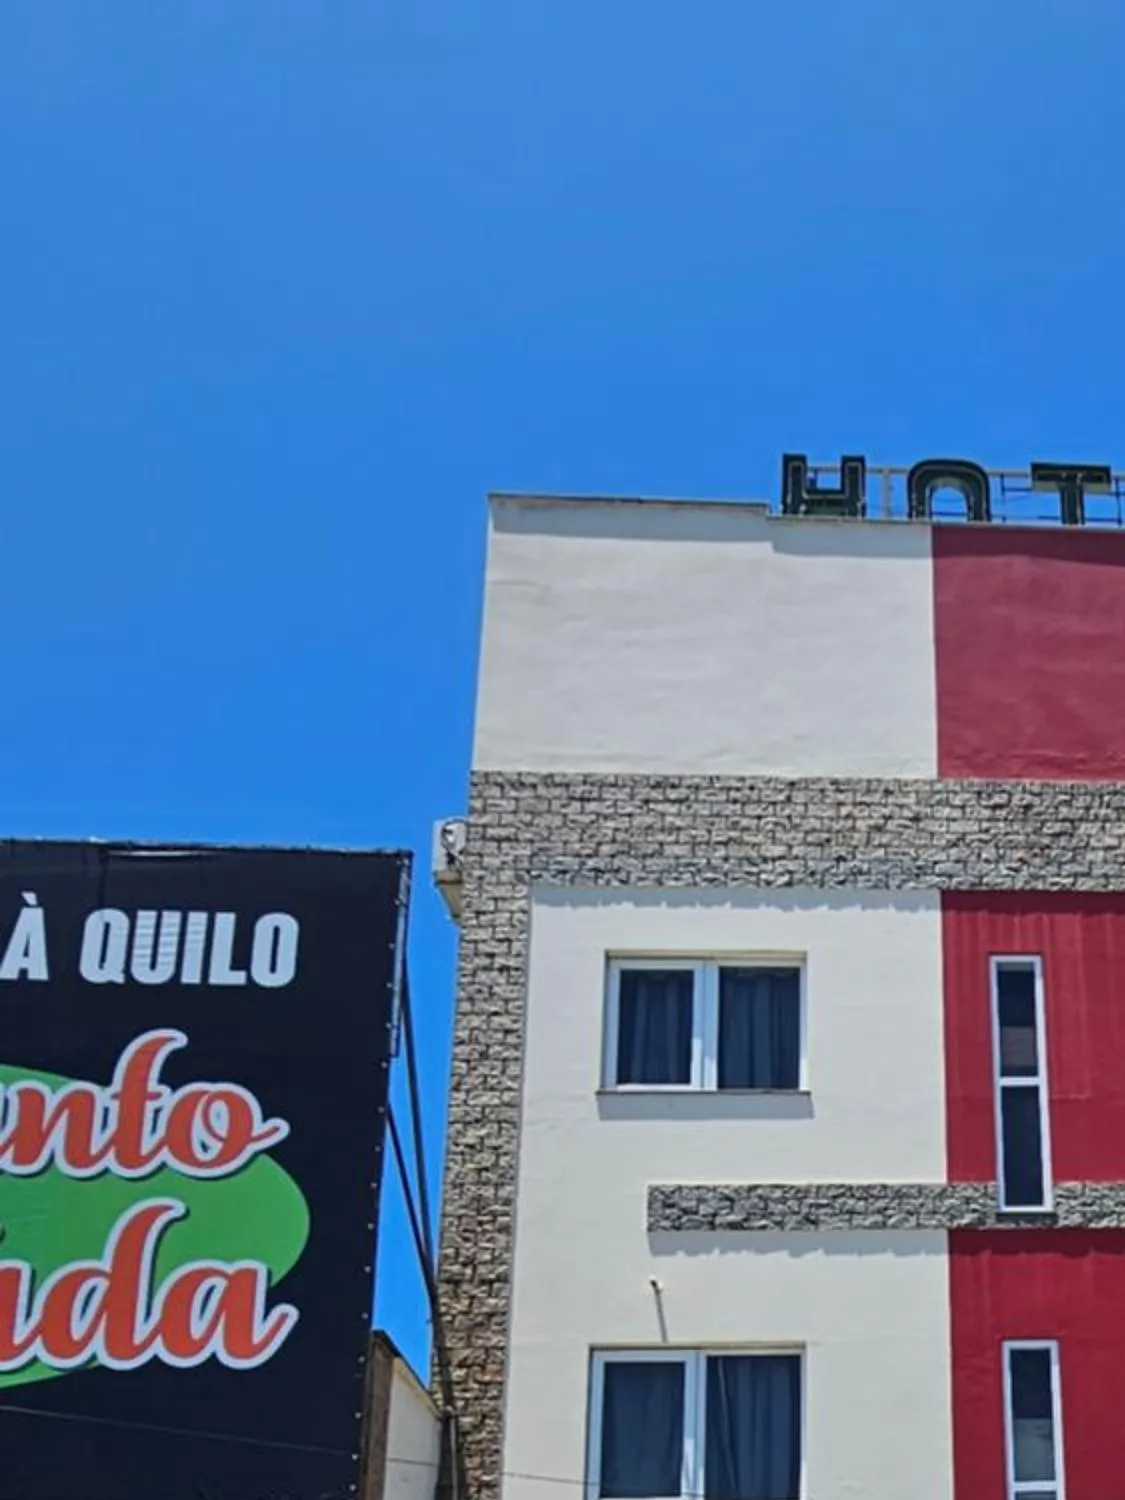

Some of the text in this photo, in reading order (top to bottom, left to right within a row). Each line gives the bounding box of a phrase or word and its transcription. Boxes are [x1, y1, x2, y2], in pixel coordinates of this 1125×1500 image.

[1, 892, 300, 989] À QUILO
[0, 1028, 291, 1179] nto
